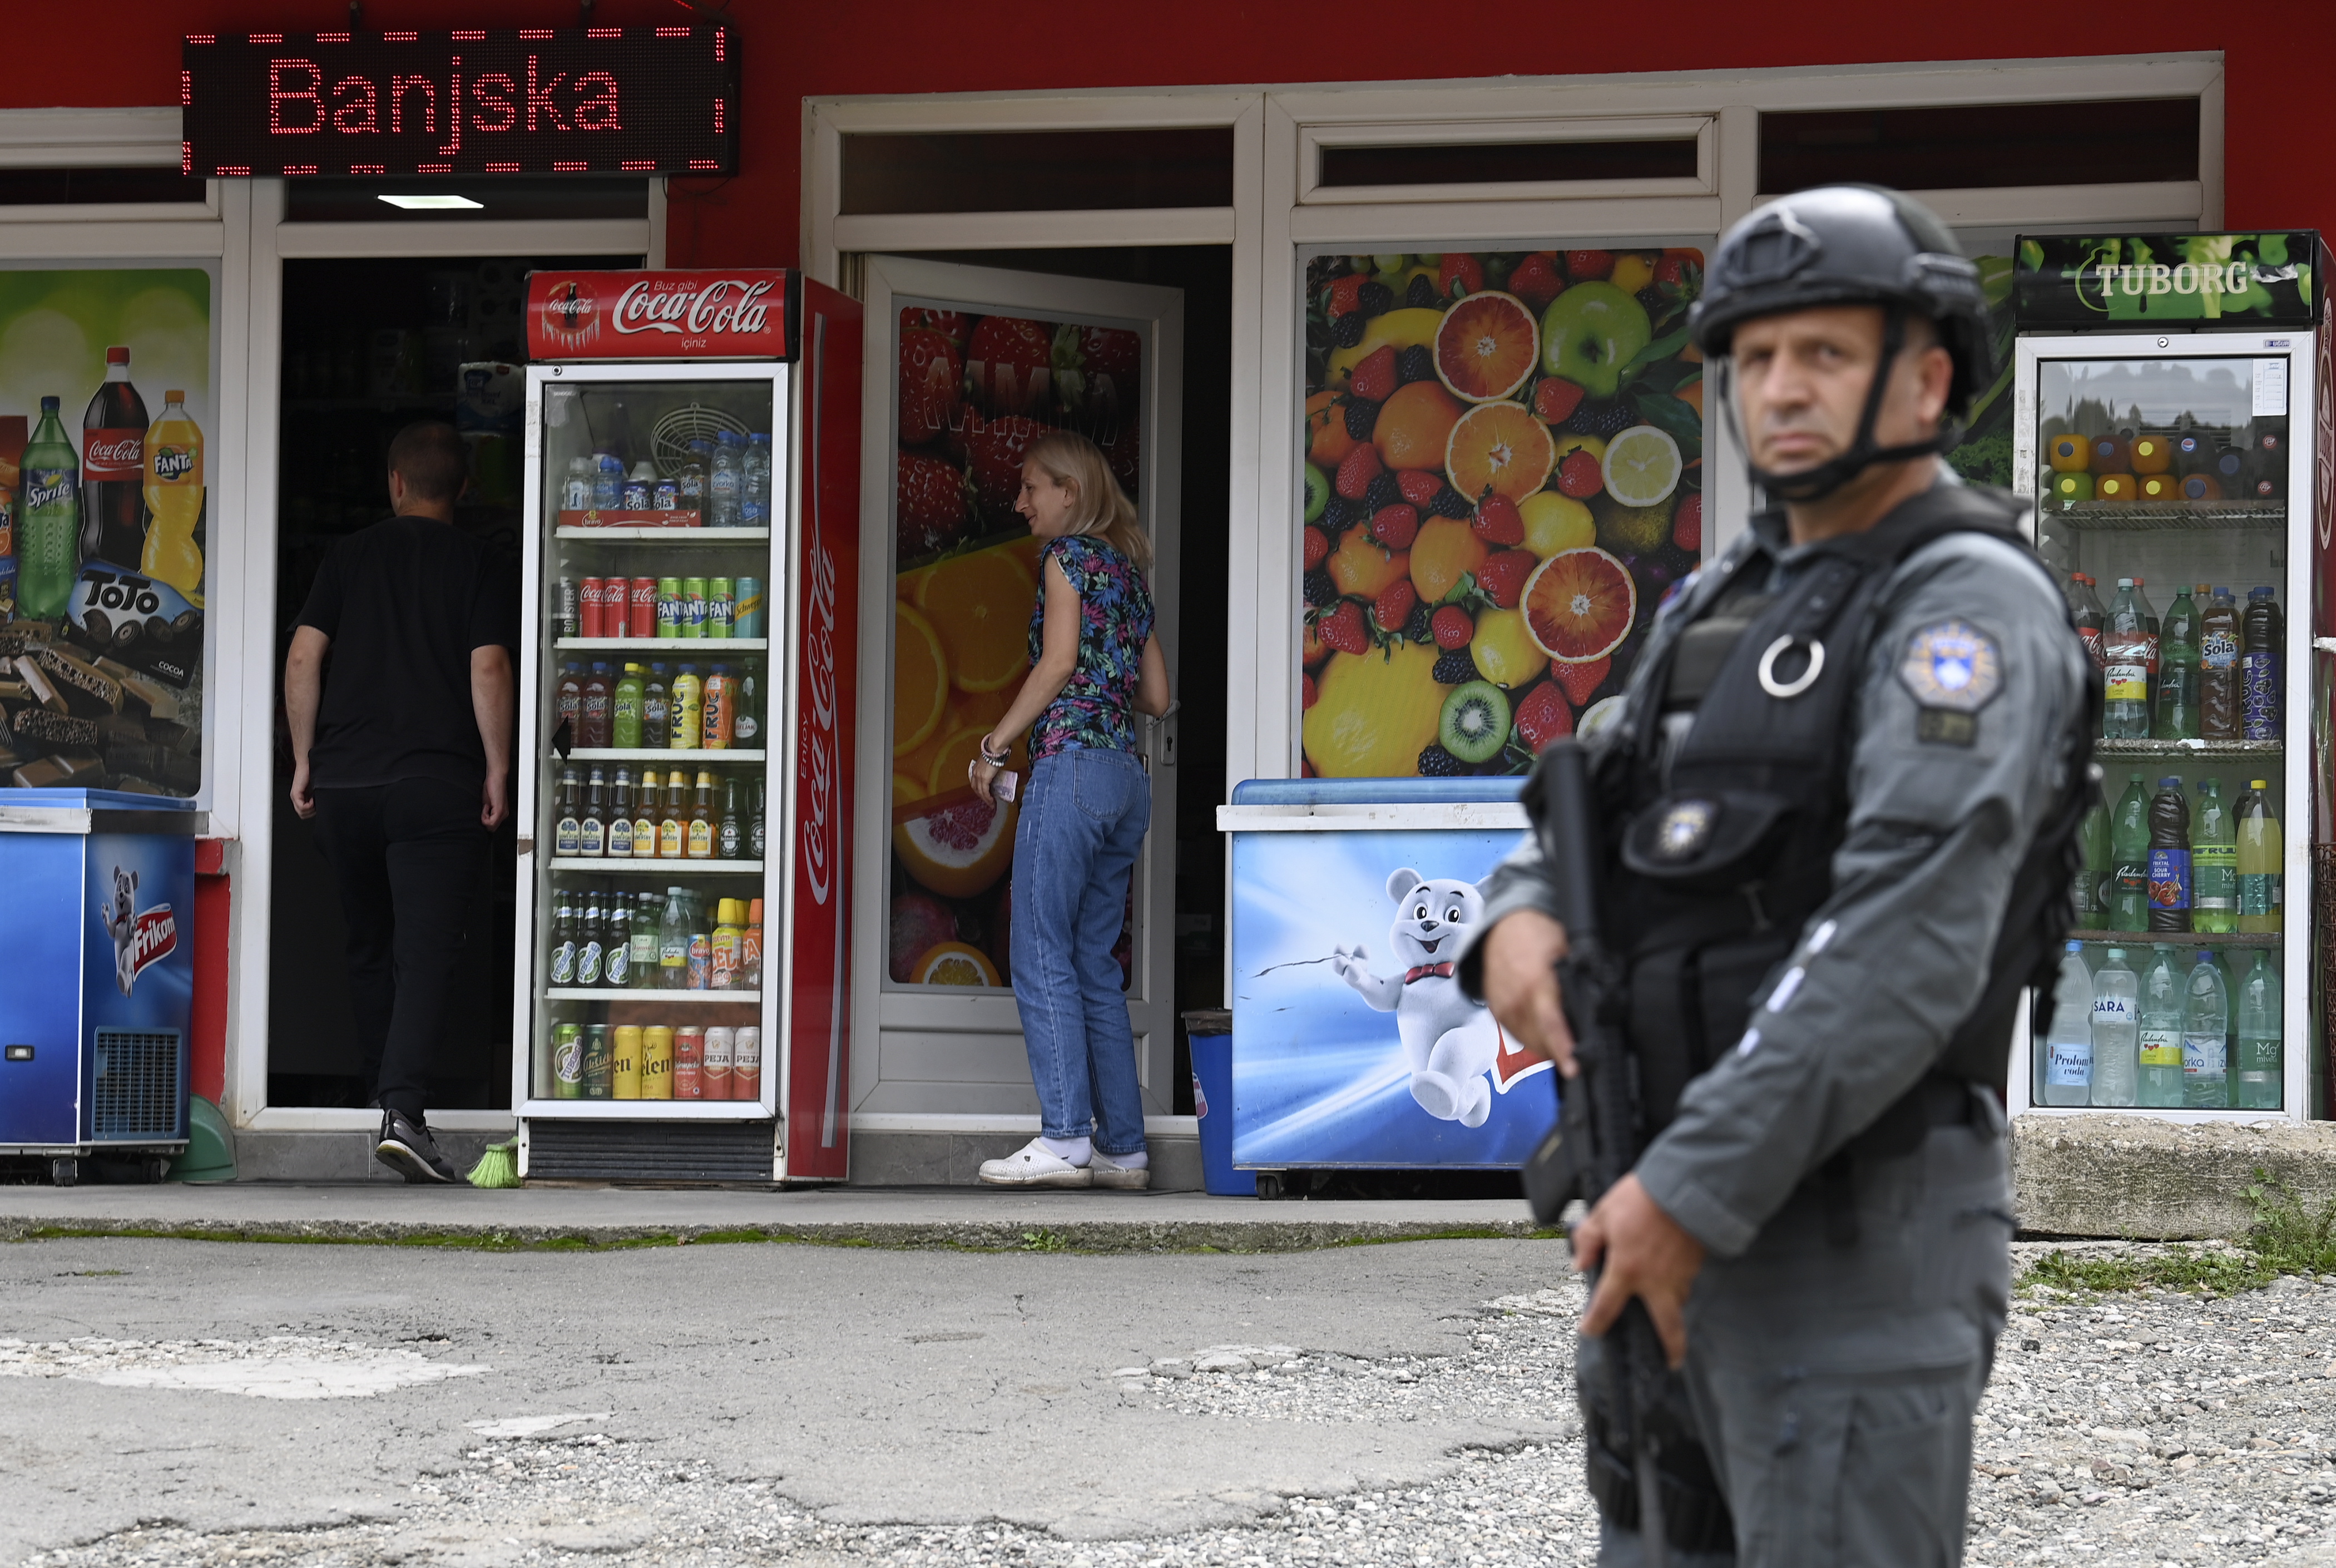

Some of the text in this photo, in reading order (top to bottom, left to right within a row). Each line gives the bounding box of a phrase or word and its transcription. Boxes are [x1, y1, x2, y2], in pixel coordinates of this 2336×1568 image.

[270, 55, 621, 155] Banjska
[654, 280, 698, 293] Buz gibi
[2096, 261, 2248, 297] TUBORG
[549, 298, 593, 315] Coca-Cola
[612, 280, 776, 334] Coca-Cola
[681, 337, 707, 349] içiniz
[88, 439, 142, 461] Coca-Cola
[154, 454, 192, 473] FANTA
[681, 478, 700, 489] Sola
[30, 481, 71, 508] Sprite
[563, 588, 575, 633] BOOSTER
[2204, 640, 2235, 657] Sola
[158, 660, 185, 678] COCOA
[560, 701, 579, 712] Sola
[587, 701, 605, 711] Sola
[615, 702, 632, 711] Sola
[647, 702, 666, 713] Sola
[804, 523, 835, 906] Coca-Cola
[671, 691, 684, 739] FRUC
[705, 691, 720, 739] FRUC
[133, 916, 175, 963] Frikom
[2094, 1000, 2125, 1012] SARA
[562, 1045, 582, 1079] TUBORG
[705, 1055, 730, 1063] PEJA
[2055, 1053, 2089, 1067] Prolom
[2064, 1067, 2085, 1076] voda
